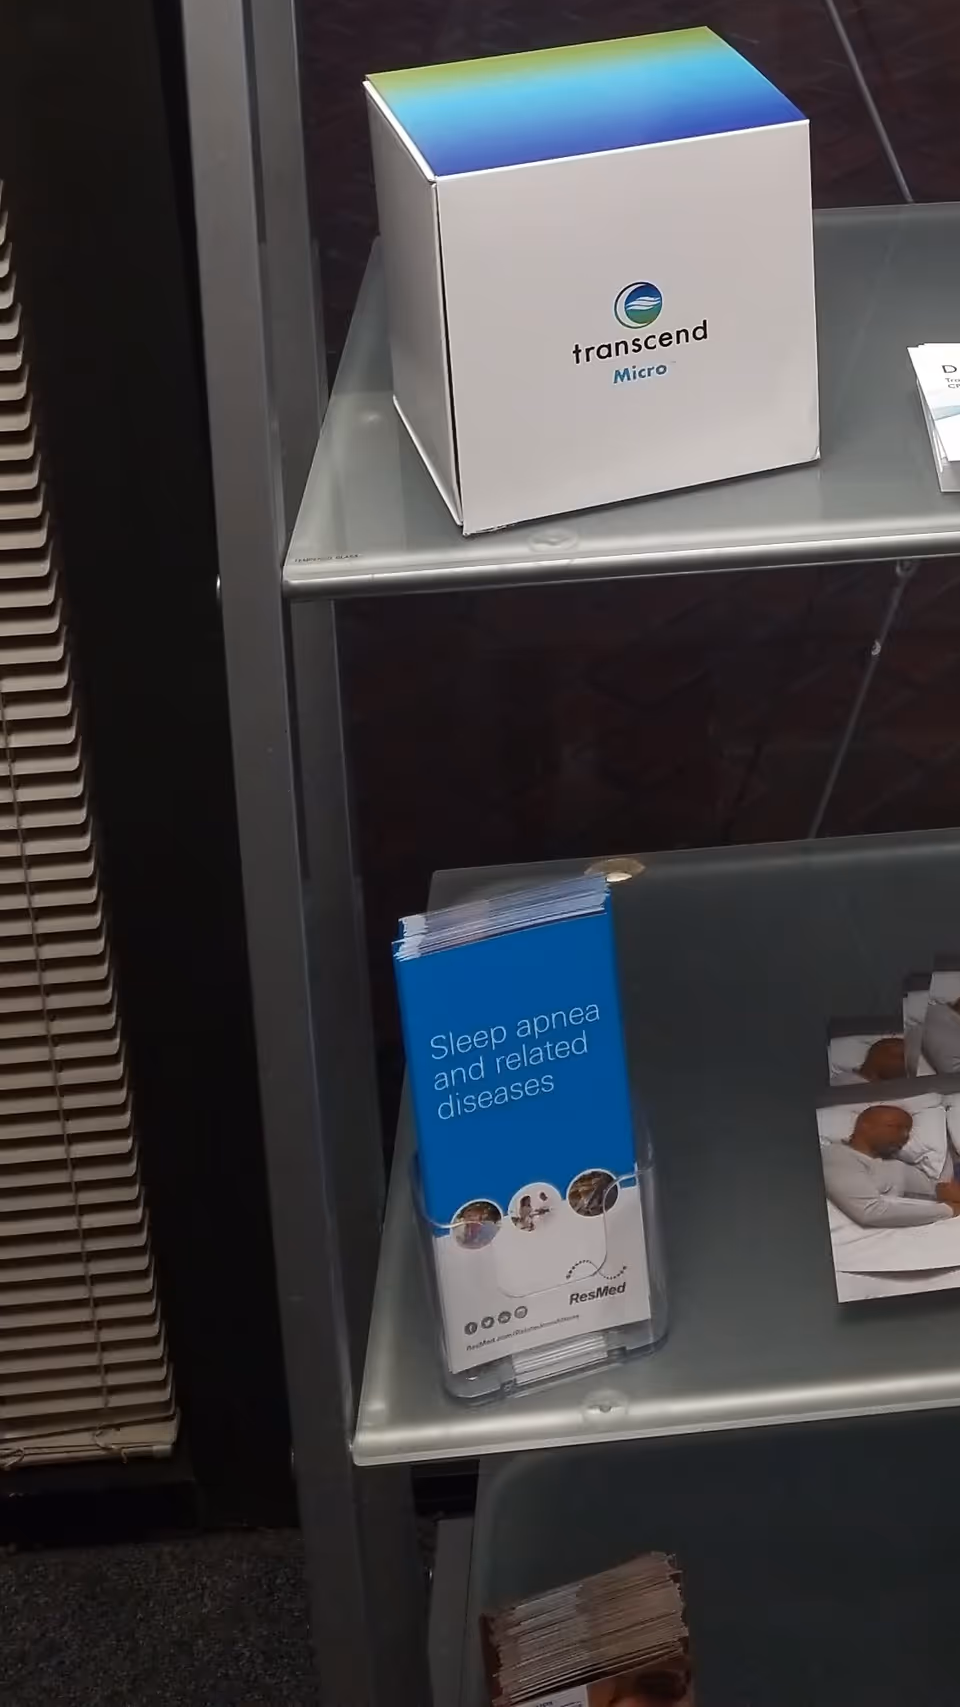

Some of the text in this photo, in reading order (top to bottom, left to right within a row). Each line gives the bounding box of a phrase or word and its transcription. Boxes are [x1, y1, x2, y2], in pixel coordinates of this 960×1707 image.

[572, 319, 709, 365] transcend
[613, 364, 668, 384] Micro
[429, 1003, 600, 1061] Sleep apnea
[433, 1029, 589, 1091] and related
[436, 1073, 555, 1121] diseases
[569, 1282, 627, 1305] ResMed
